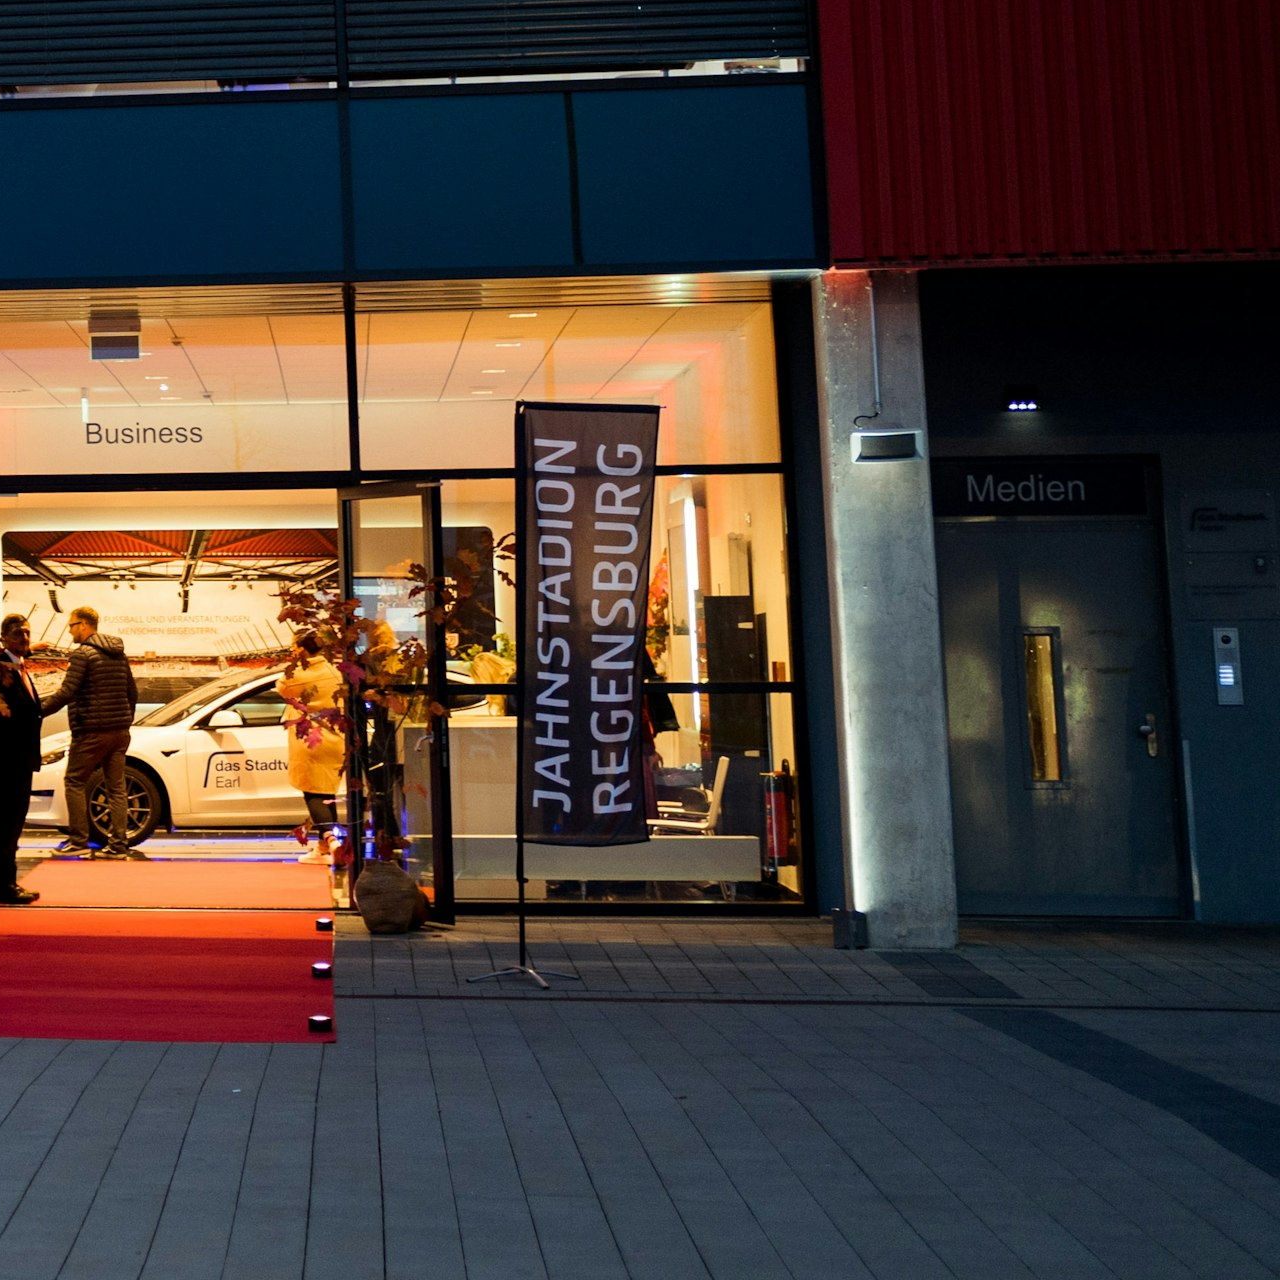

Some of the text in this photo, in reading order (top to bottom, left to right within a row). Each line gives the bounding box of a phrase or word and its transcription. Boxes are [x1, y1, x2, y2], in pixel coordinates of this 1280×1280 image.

[85, 421, 204, 445] Business
[966, 473, 1087, 504] Medien
[103, 615, 250, 624] FUSSBALL UND VERANSTALTUNGEN
[532, 437, 578, 814] JAHNSTADION
[117, 626, 165, 635] MENSCHEN
[589, 442, 644, 816] REGENSBURG
[215, 761, 241, 773] das
[215, 776, 241, 789] Earl
